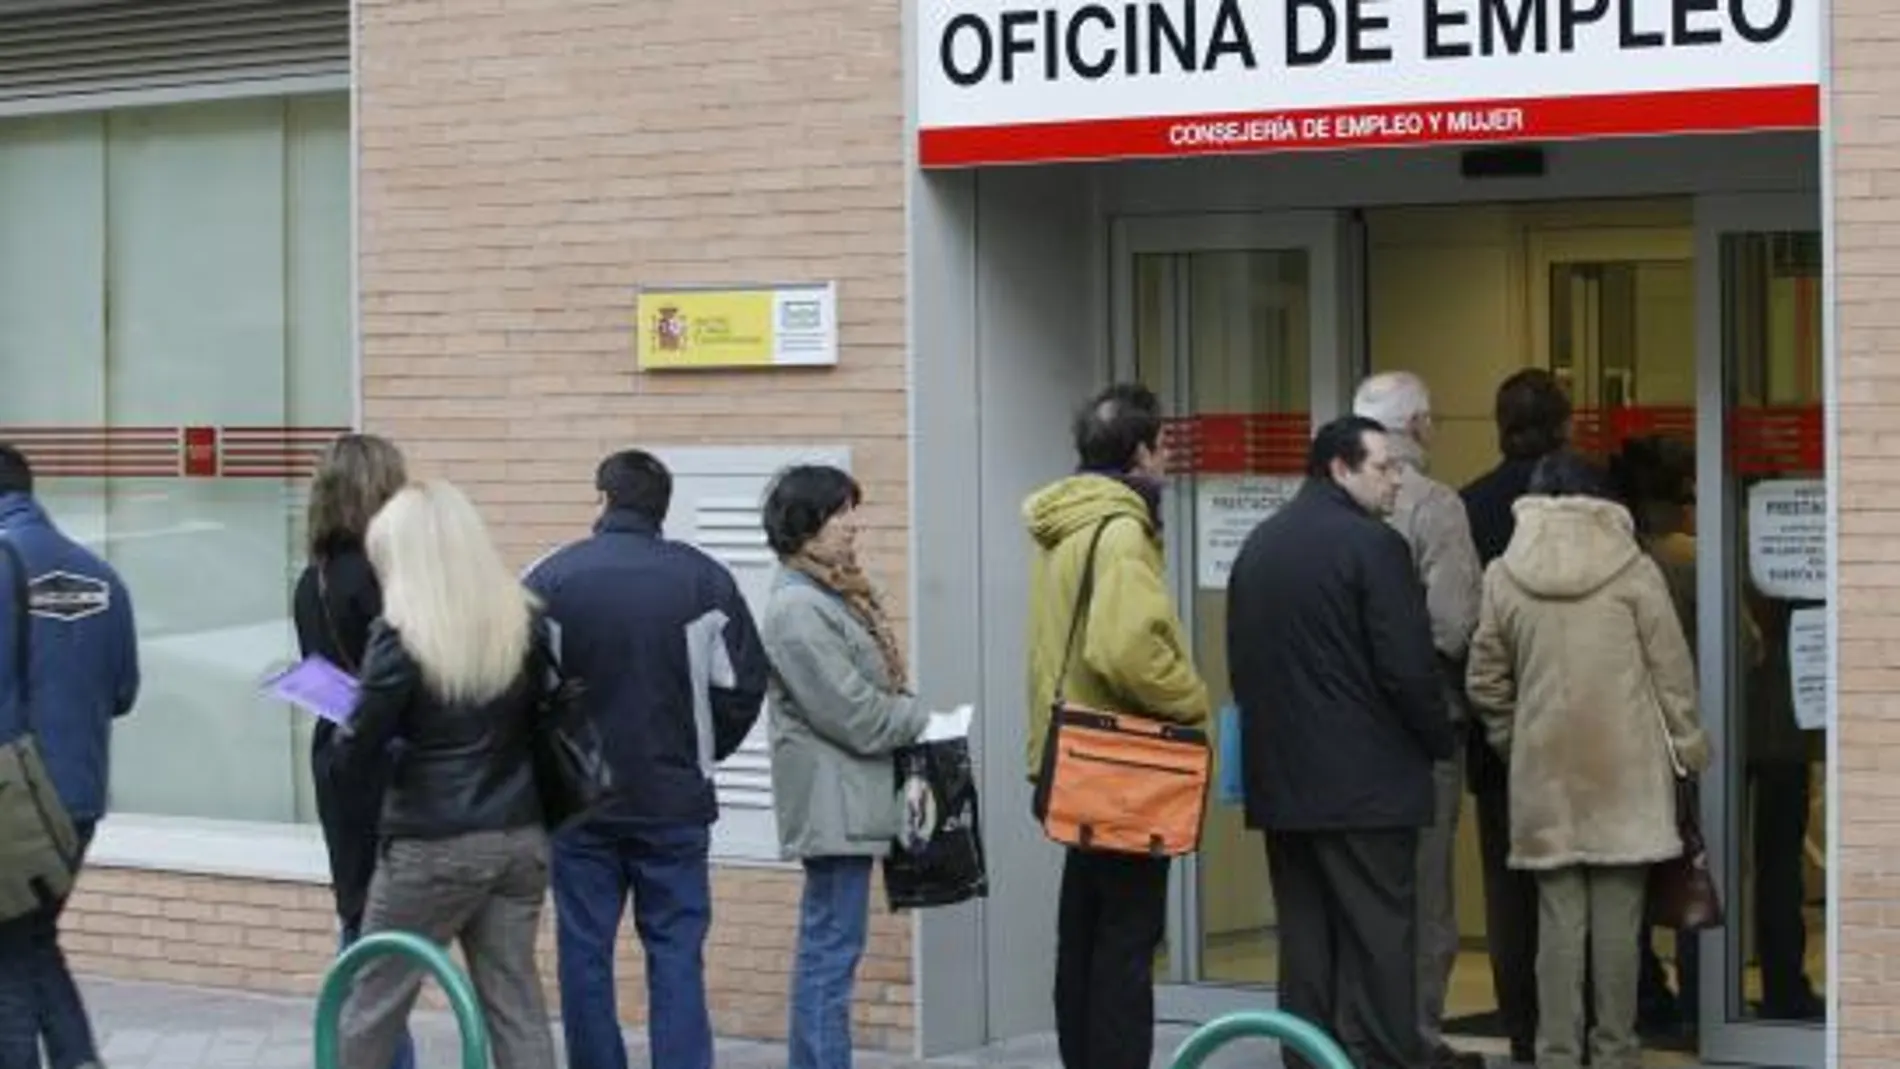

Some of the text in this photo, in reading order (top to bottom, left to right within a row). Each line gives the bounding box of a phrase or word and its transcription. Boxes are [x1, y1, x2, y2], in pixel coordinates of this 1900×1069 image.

[940, 0, 1793, 87] OFICINA DE EMPLEO
[1170, 108, 1523, 145] CONSEJERÍA DE EMPLEO Y MUJER
